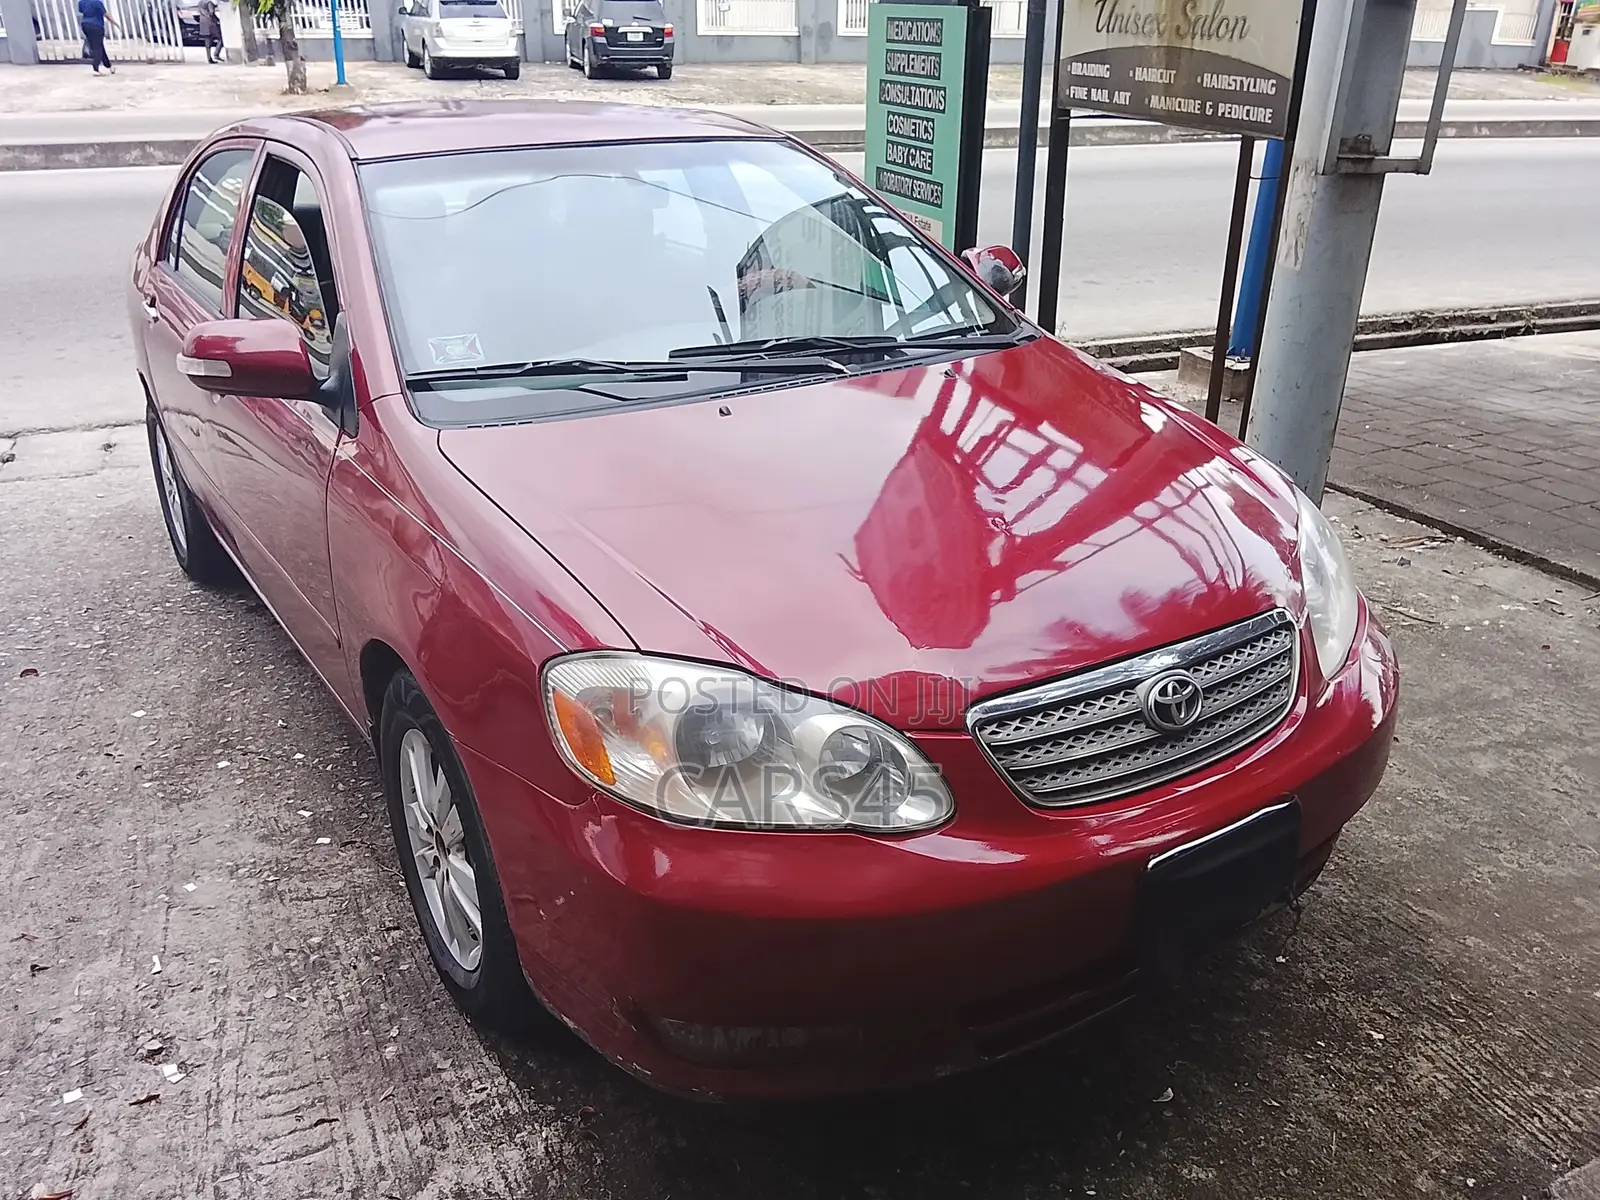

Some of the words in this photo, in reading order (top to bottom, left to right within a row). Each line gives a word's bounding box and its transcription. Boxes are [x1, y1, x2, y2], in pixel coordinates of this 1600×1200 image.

[887, 20, 942, 43] MEDICATIONS
[1095, 0, 1167, 38] Unisex
[1175, 0, 1249, 42] Salon
[886, 52, 940, 76] SUPPLEMENTS
[1071, 61, 1110, 78] BRAIDING
[1135, 66, 1176, 84] HAIRCUT
[880, 82, 945, 110] CONSULTATIONS
[1069, 85, 1088, 100] FINE
[1090, 87, 1110, 103] NAIL
[1112, 90, 1131, 105] ART
[1203, 72, 1277, 95] HAIRSTYLING
[1149, 94, 1201, 114] MANICURE
[1205, 101, 1213, 116] &
[1217, 102, 1273, 124] PEDICURE
[887, 114, 934, 141] COSMETICS
[887, 143, 908, 165] BABY
[909, 148, 932, 171] CARE
[912, 179, 942, 205] SERVICES
